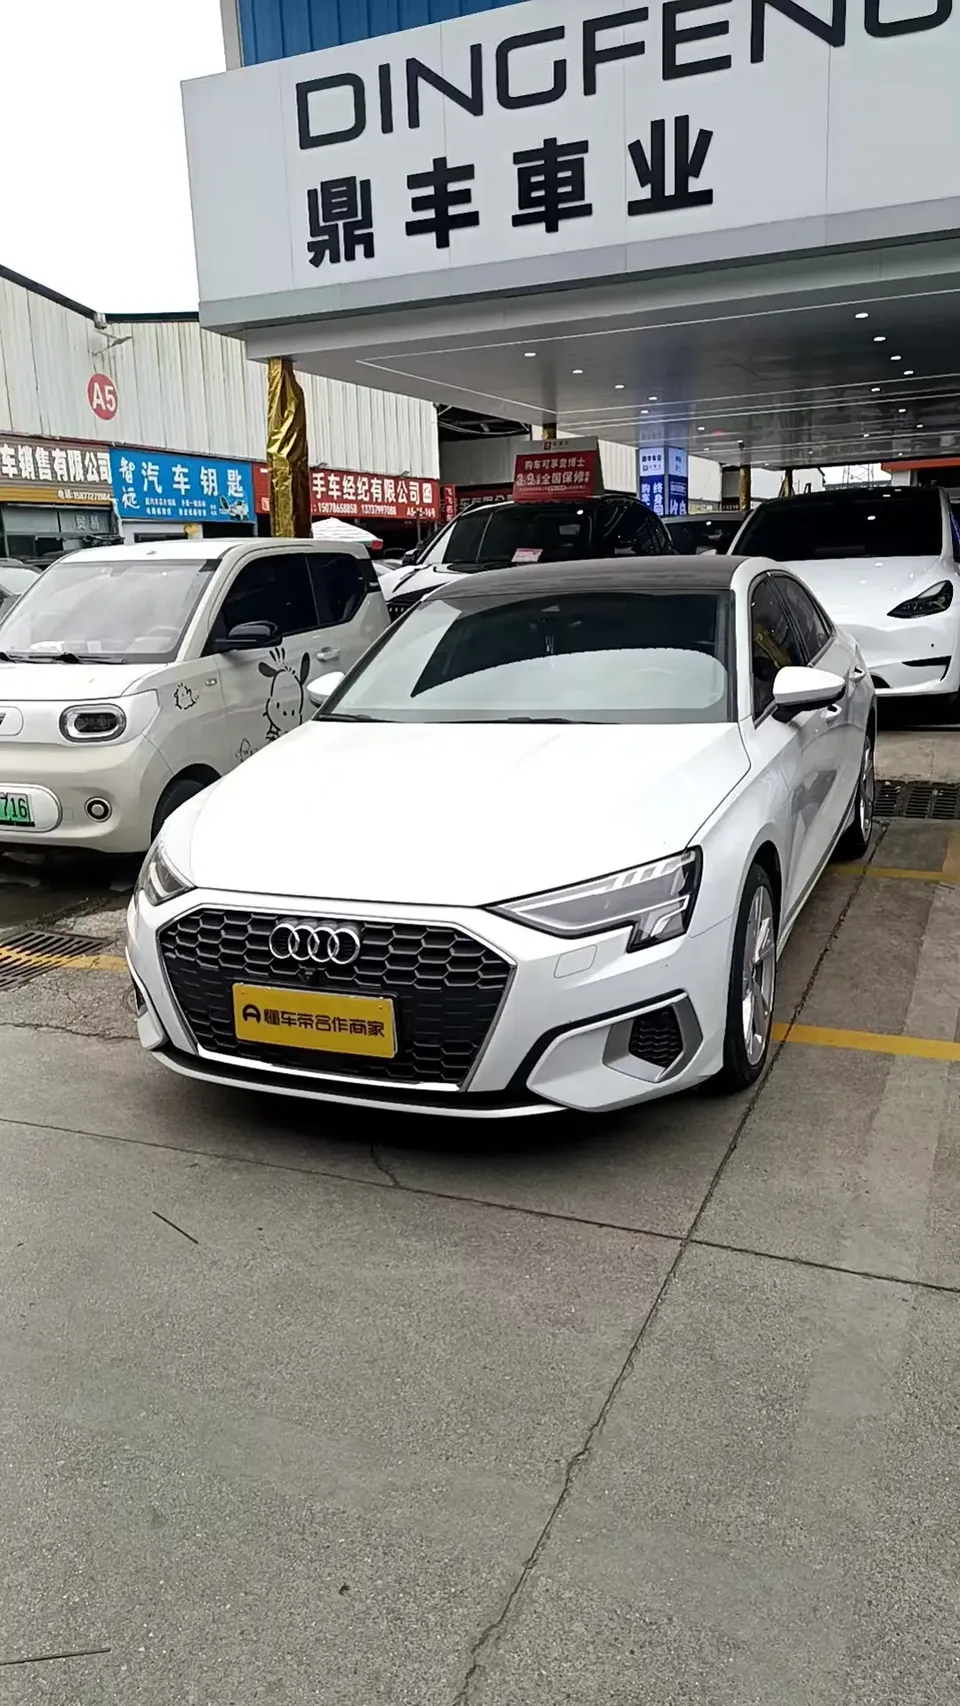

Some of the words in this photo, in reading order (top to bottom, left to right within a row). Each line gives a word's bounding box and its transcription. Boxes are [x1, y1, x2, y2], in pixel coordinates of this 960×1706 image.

[306, 114, 714, 268] 鼎丰車业
[92, 382, 117, 412] A5
[0, 443, 112, 485] 车销售有限公司
[141, 461, 245, 498] 汽车钥匙
